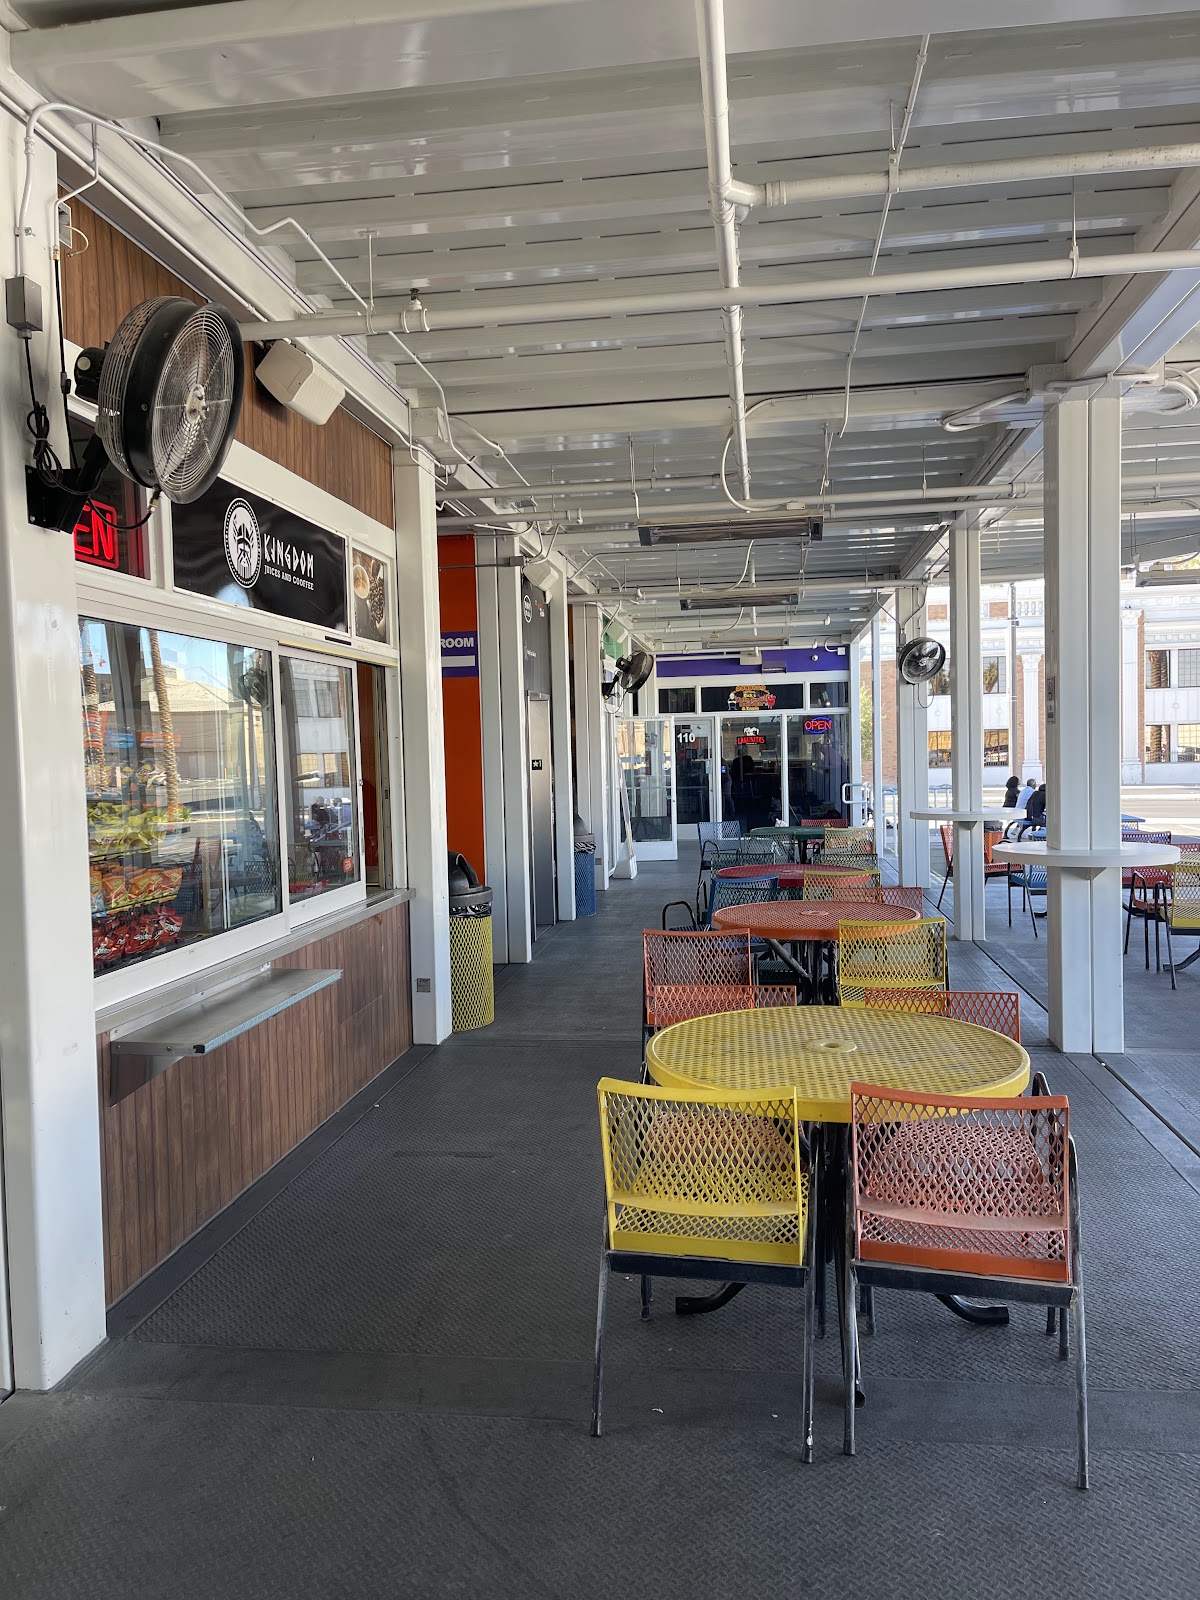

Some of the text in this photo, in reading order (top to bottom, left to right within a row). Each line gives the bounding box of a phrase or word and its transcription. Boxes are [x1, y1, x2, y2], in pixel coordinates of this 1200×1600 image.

[264, 533, 314, 579] KINGDOM
[264, 564, 281, 579] JUICES
[281, 571, 292, 583] AND
[804, 720, 832, 730] OPEN
[677, 732, 696, 743] 110
